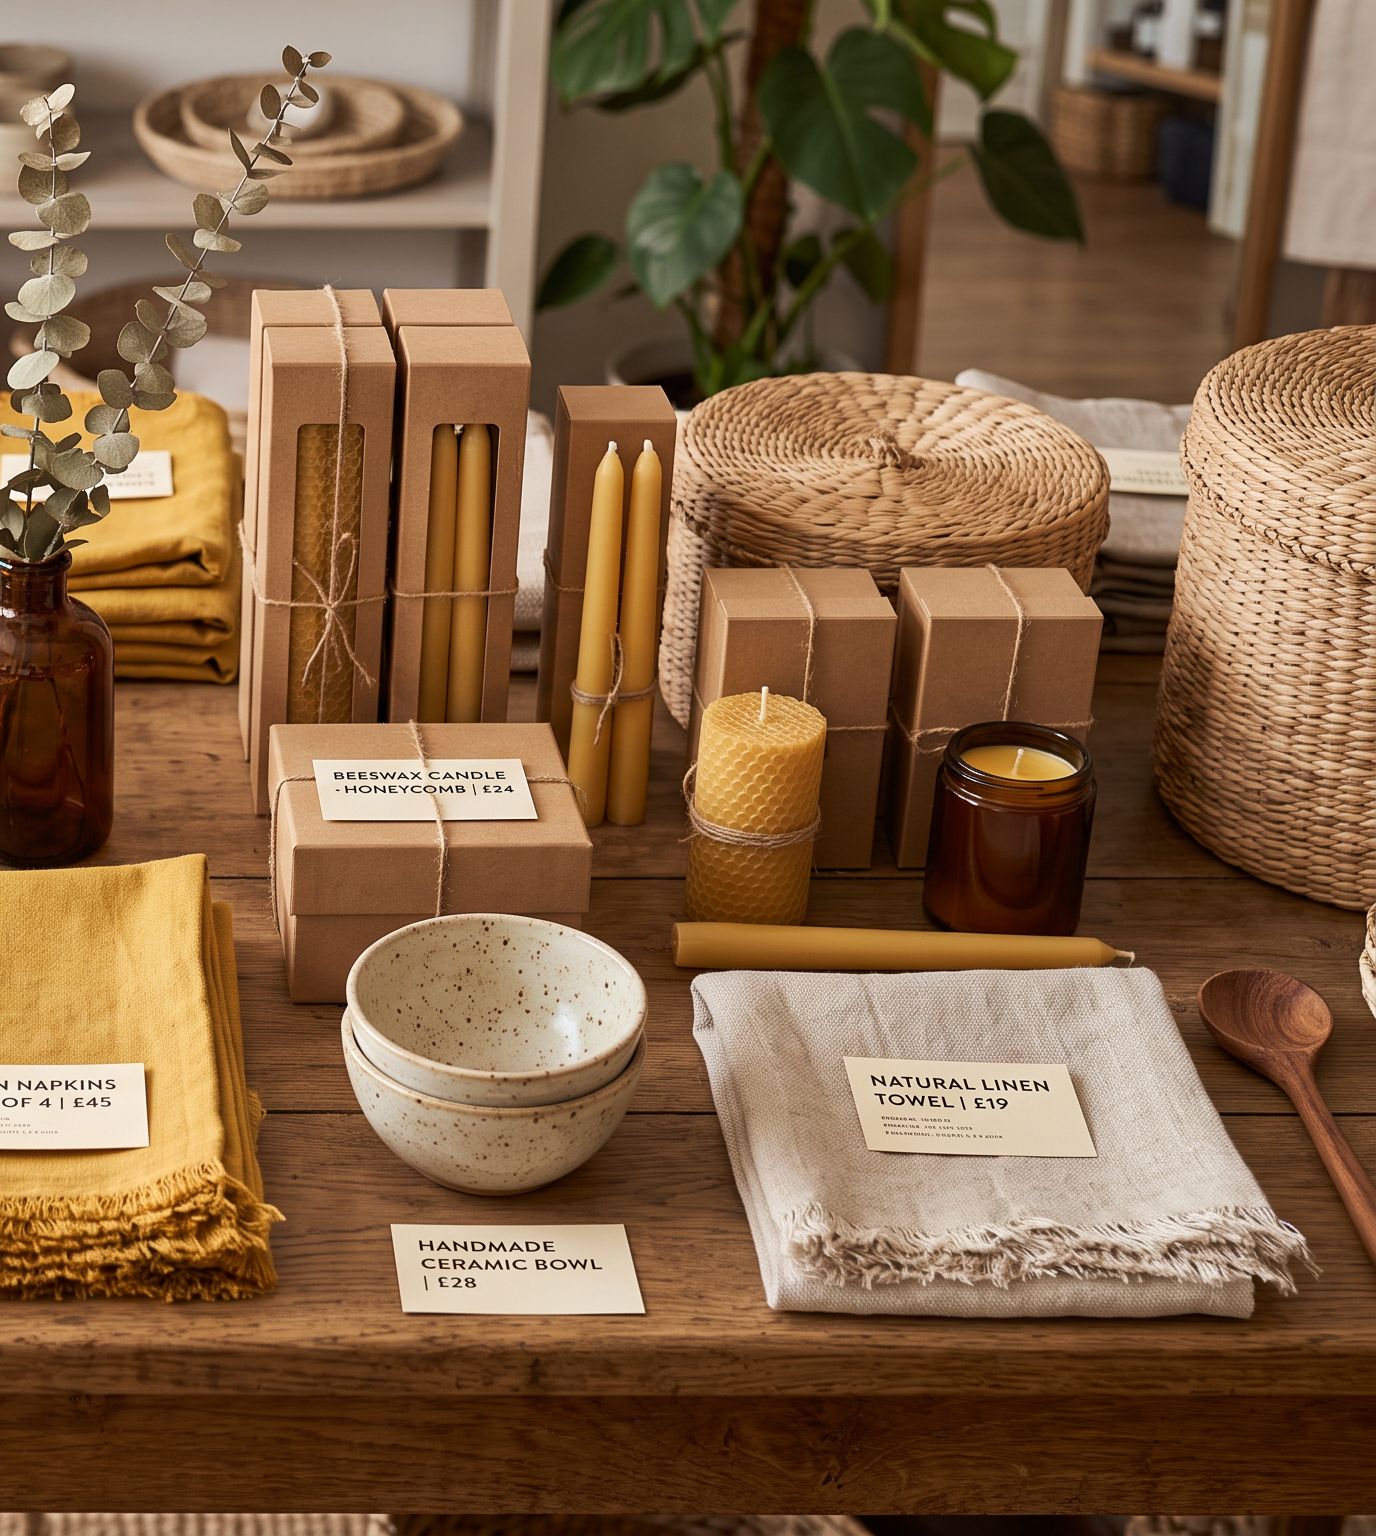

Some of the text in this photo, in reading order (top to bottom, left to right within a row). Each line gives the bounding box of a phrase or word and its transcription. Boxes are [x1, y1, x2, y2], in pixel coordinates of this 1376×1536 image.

[333, 771, 507, 781] BEESWAX CANDLE
[344, 784, 466, 795] HONEYCOMB
[482, 784, 515, 794] £24
[17, 1079, 116, 1091] NAPKINS
[870, 1074, 1050, 1093] NATURAL LINEN
[1, 1097, 33, 1108] OF
[38, 1097, 52, 1109] 4
[72, 1096, 112, 1108] £45
[873, 1092, 955, 1109] TOWEL
[974, 1097, 1009, 1110] £19
[418, 1239, 556, 1253] HANDMADE
[420, 1258, 603, 1271] CERAMIC BOWL
[437, 1276, 477, 1289] £28
